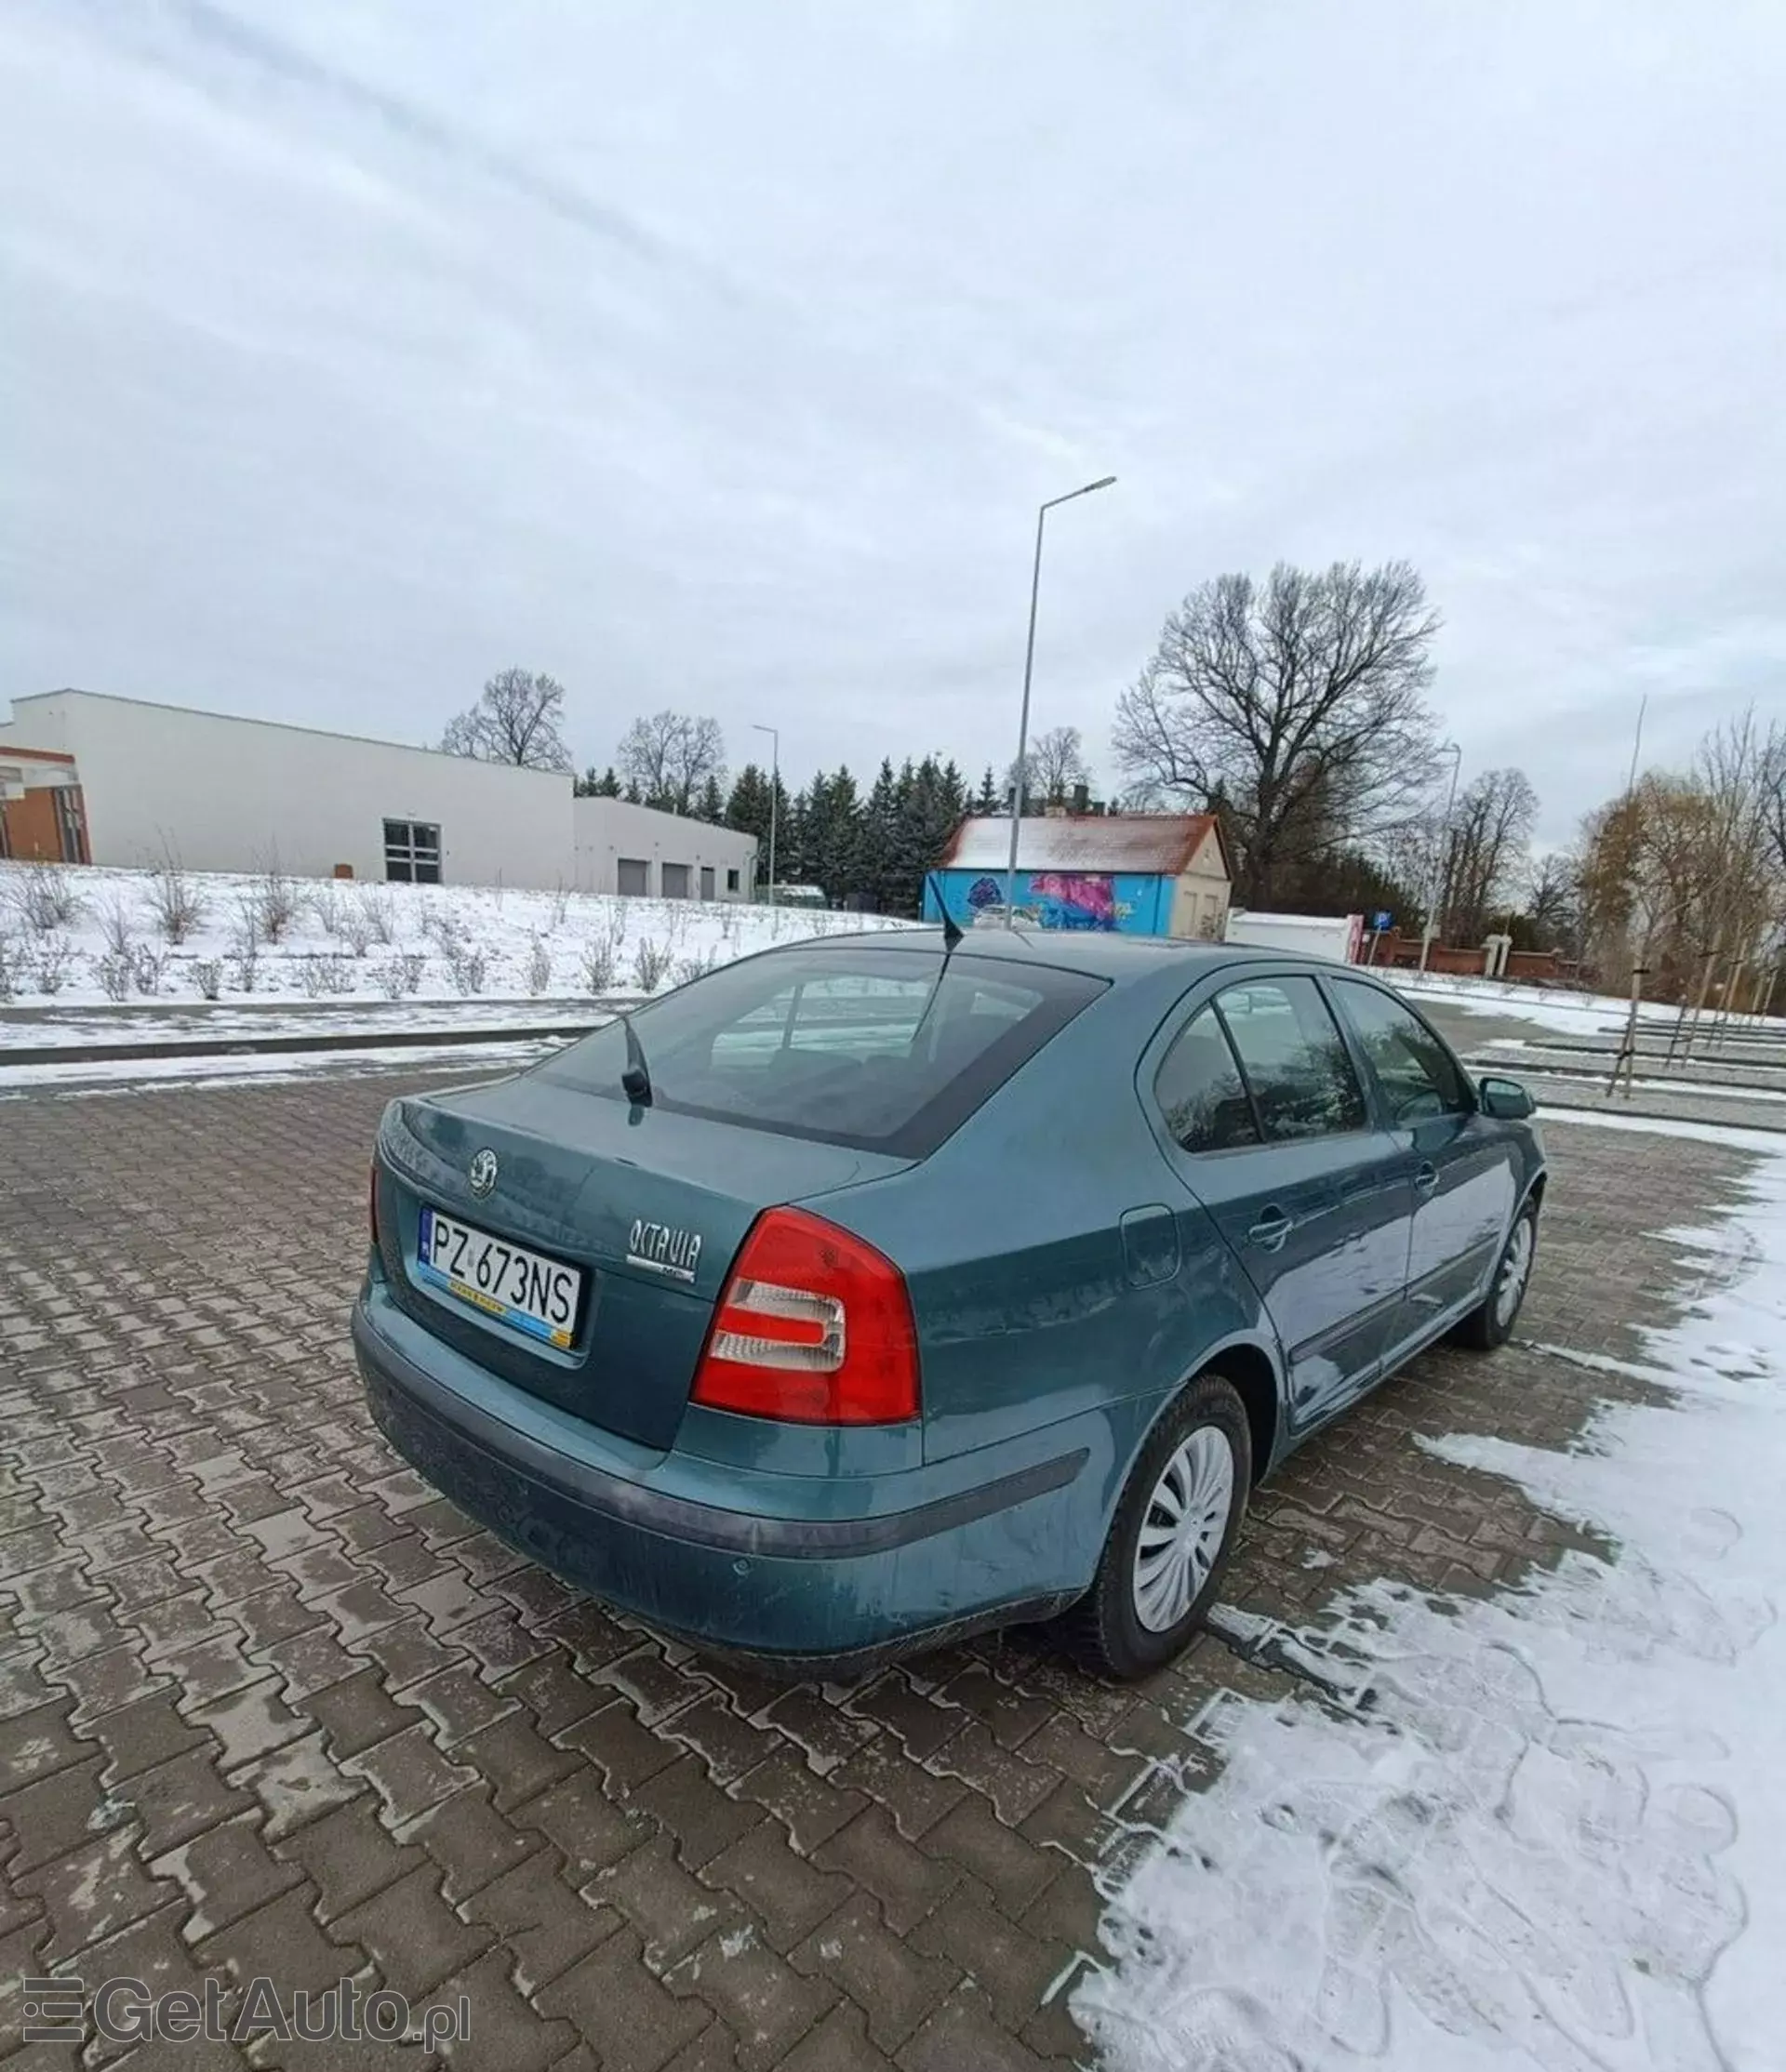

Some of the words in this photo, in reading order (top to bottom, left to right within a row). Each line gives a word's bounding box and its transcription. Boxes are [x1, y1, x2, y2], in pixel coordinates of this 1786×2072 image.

[434, 1220, 469, 1279] PZ
[476, 1242, 573, 1323] 673NS
[629, 1219, 701, 1269] OCTAVIA
